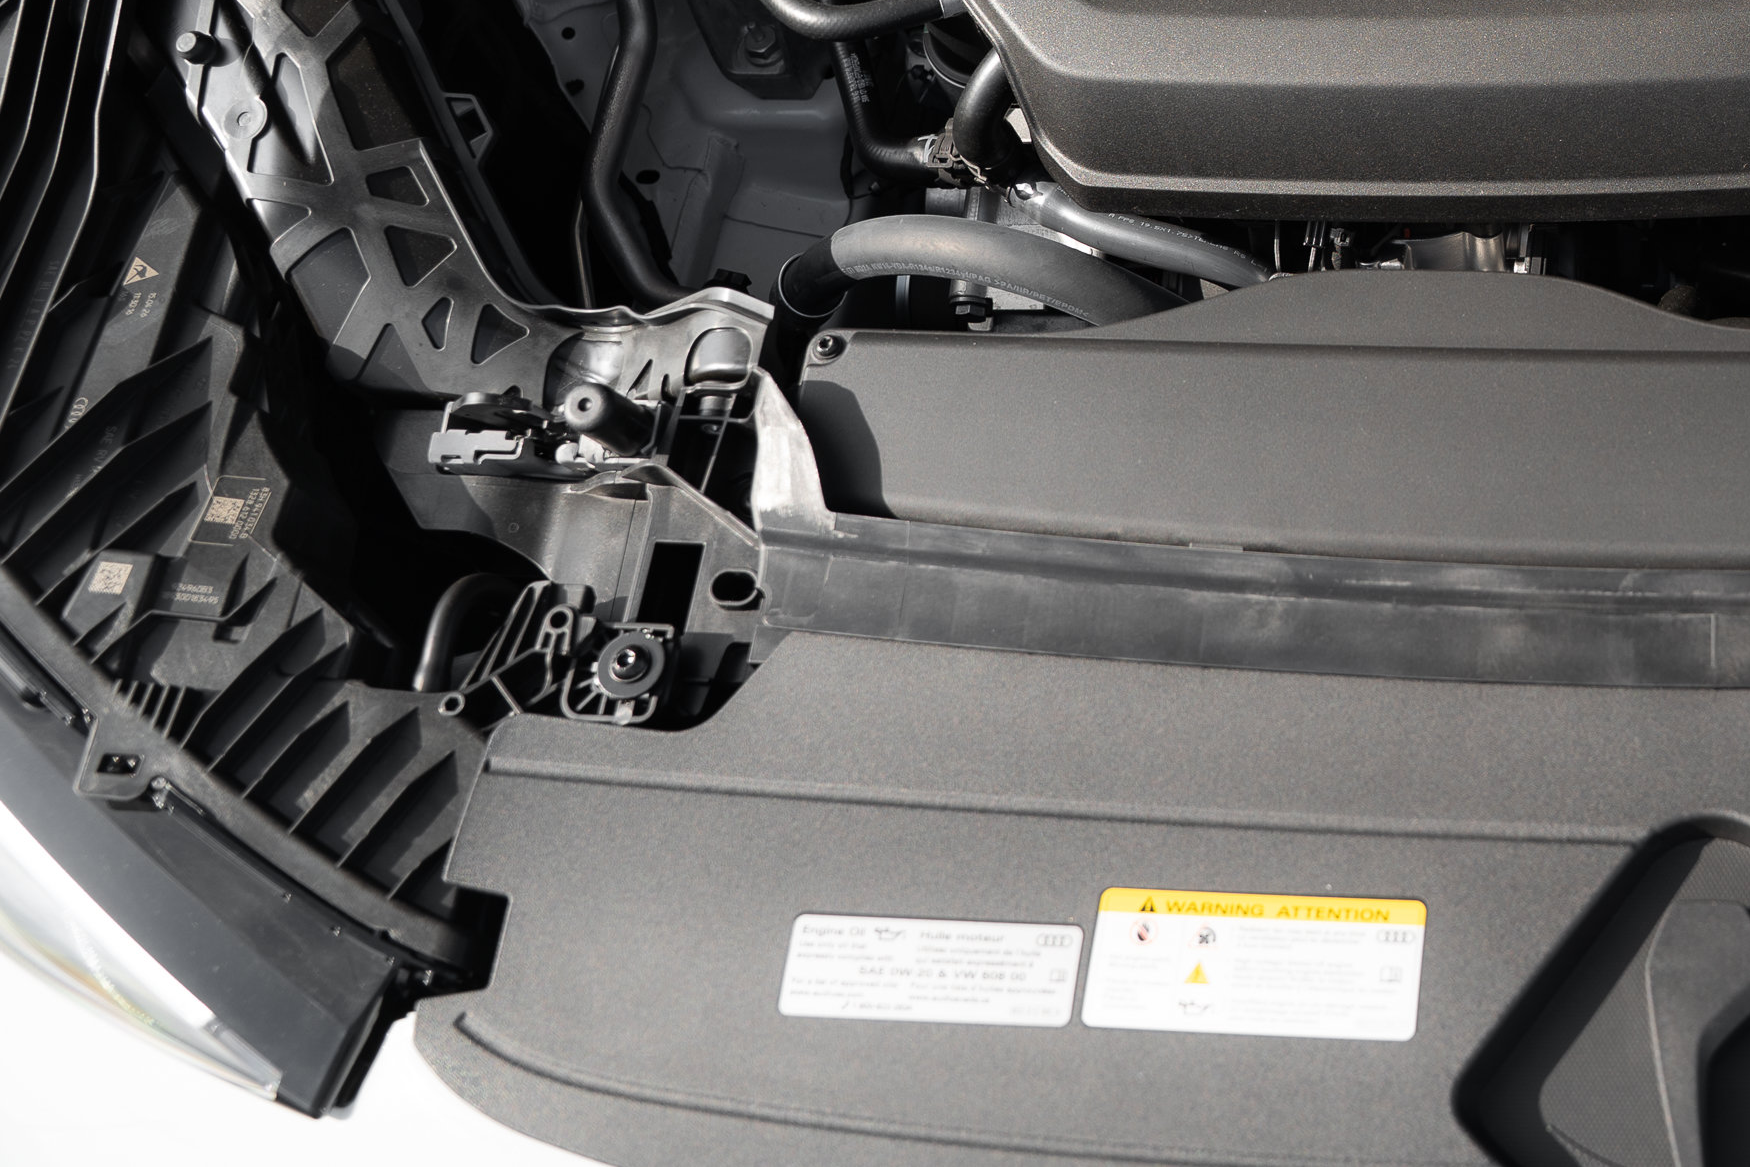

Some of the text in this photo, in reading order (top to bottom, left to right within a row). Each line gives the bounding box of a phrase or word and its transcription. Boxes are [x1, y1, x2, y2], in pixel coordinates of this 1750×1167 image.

[1165, 900, 1391, 923] WARNING ATTENTION
[802, 925, 866, 937] Engine Oil
[919, 931, 1005, 943] Huile moteur
[858, 965, 886, 975] SAE
[954, 969, 976, 980] VW
